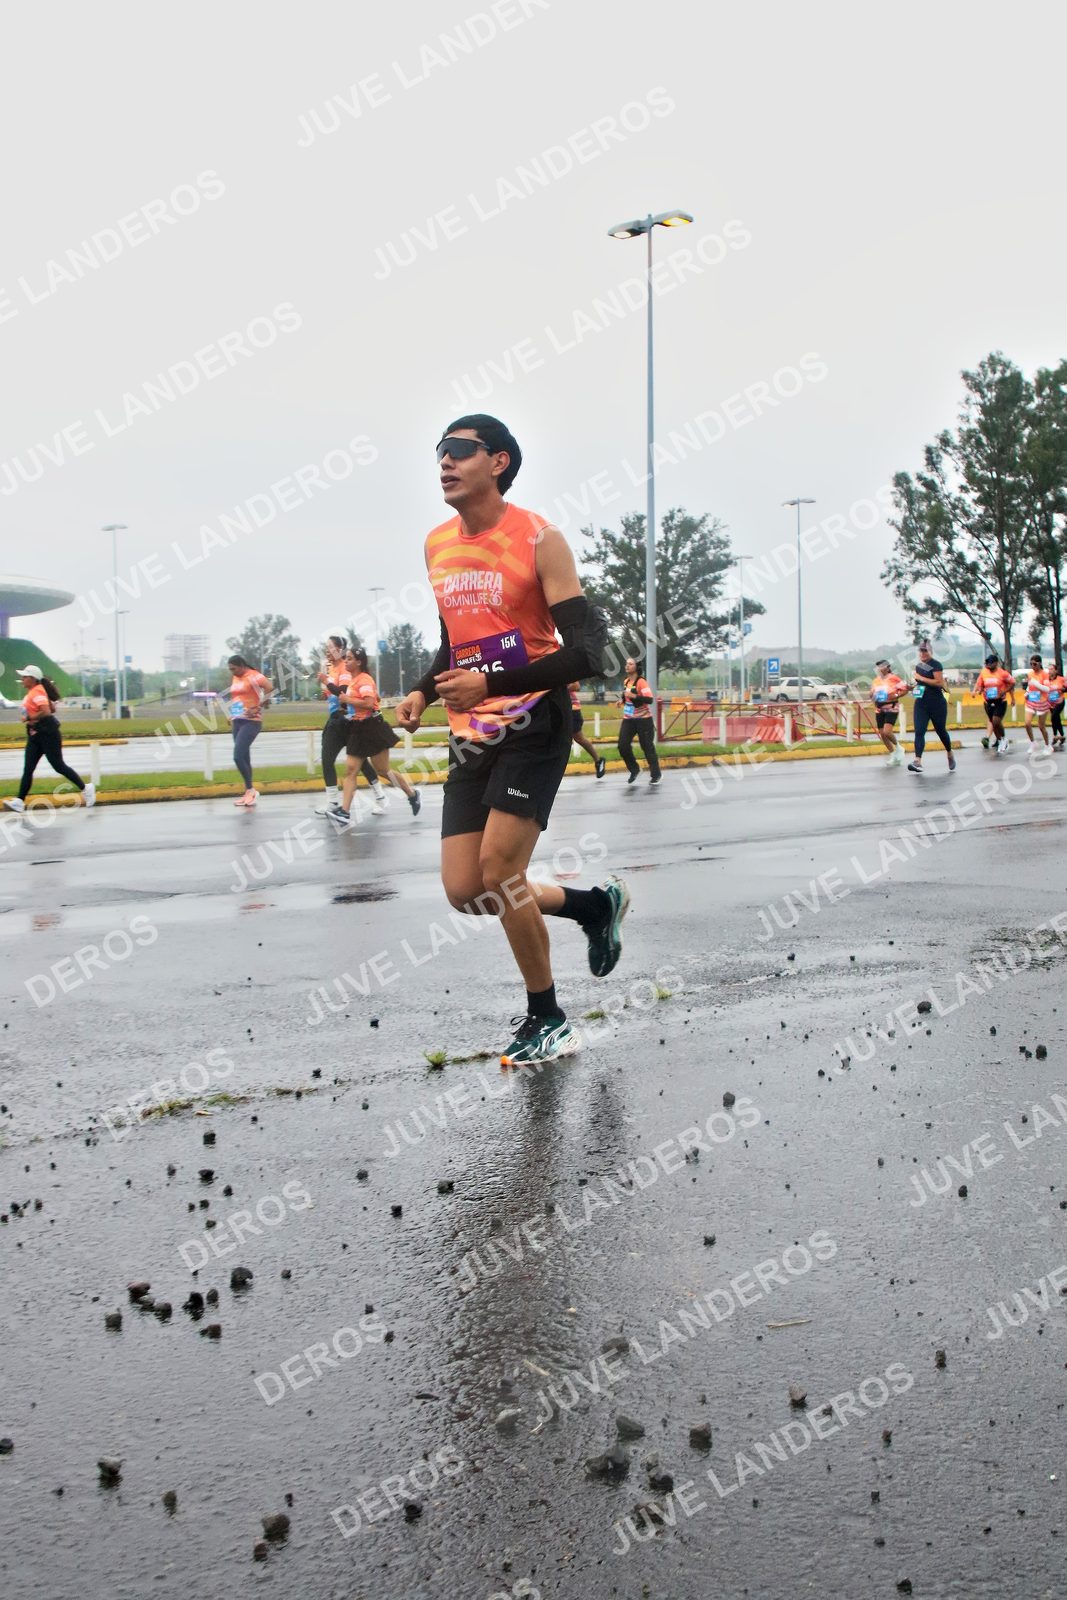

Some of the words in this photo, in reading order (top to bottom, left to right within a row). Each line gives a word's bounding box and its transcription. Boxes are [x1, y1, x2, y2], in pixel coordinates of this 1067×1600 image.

[443, 570, 503, 593] CARRERA
[444, 592, 488, 608] OMNILIFE
[500, 634, 517, 649] 15K
[507, 787, 529, 799] Wilson
